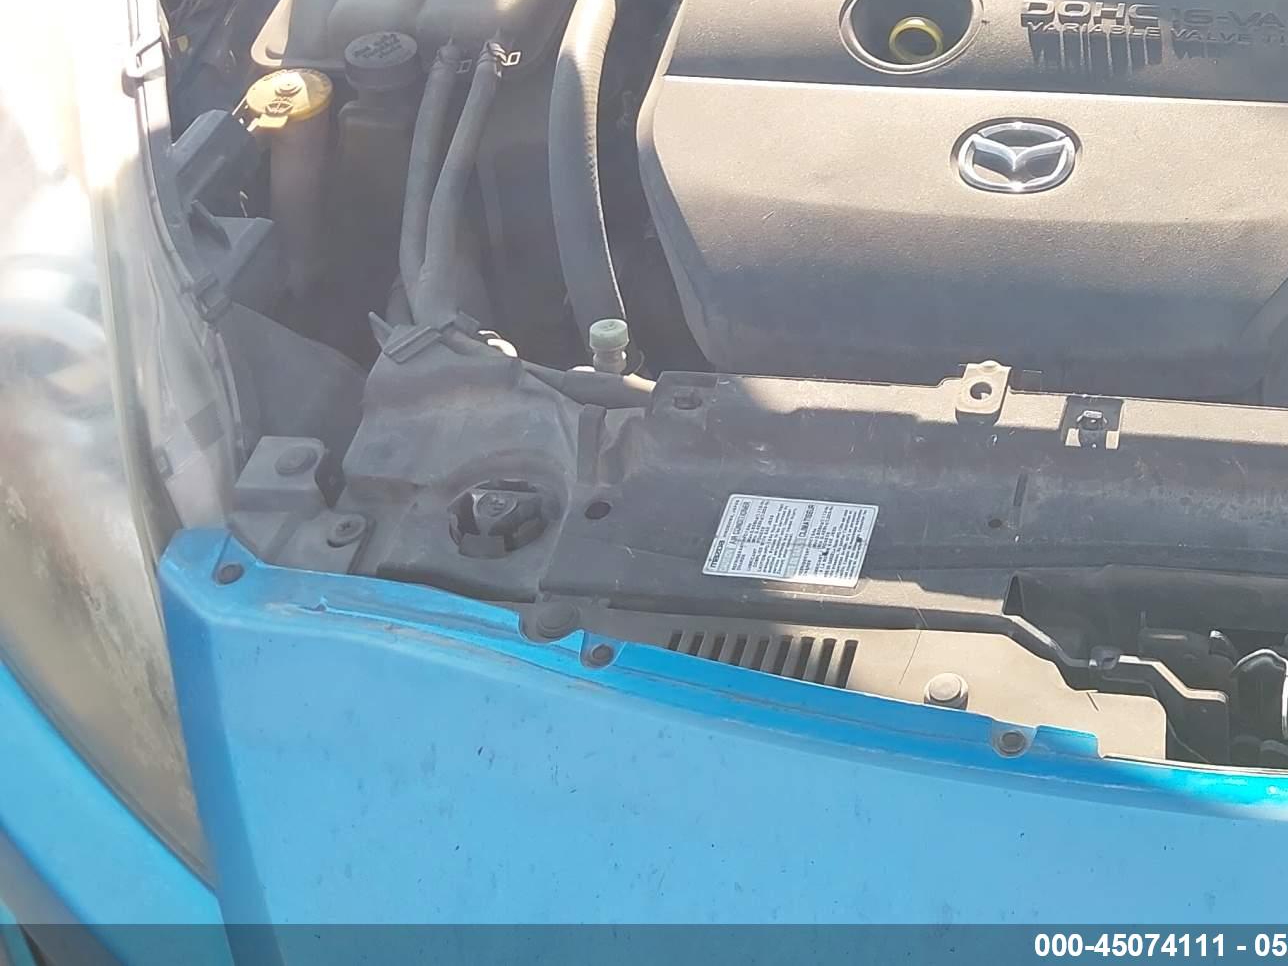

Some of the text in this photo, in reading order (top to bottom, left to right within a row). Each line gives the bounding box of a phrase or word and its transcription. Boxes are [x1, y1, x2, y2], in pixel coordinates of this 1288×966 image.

[1022, 0, 1160, 22] DOHC
[1027, 20, 1161, 37] VARIABLE
[1171, 27, 1252, 45] VALVE
[711, 540, 725, 568] mazda
